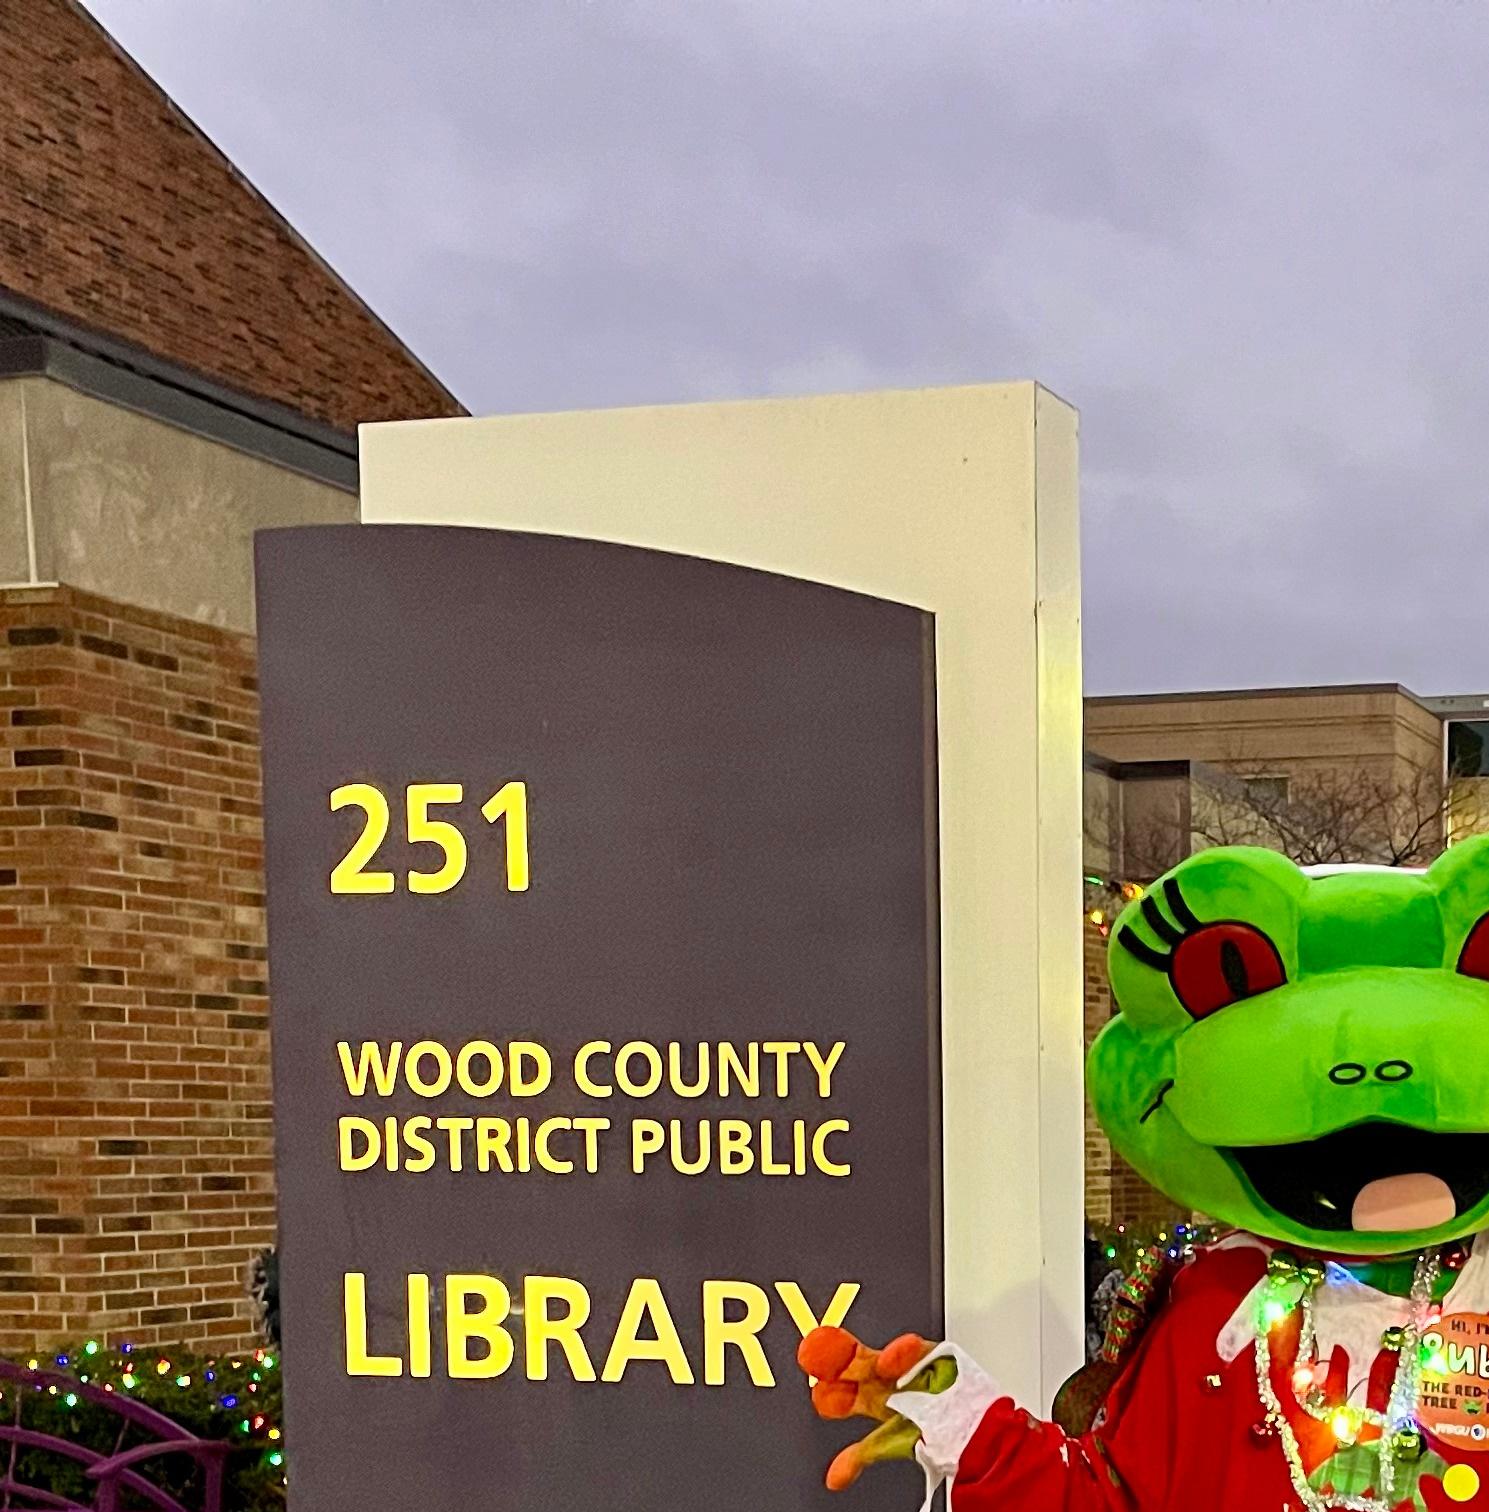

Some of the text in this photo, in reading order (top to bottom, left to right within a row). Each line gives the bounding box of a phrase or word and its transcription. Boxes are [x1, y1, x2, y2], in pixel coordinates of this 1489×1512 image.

[330, 781, 529, 894] 251
[336, 1040, 846, 1098] WOOD COUNTY
[338, 1115, 851, 1177] DISTRICT PUBLIC
[344, 1272, 860, 1388] LIBRARY
[1422, 1381, 1449, 1395] THE
[1422, 1395, 1457, 1410] TREE
